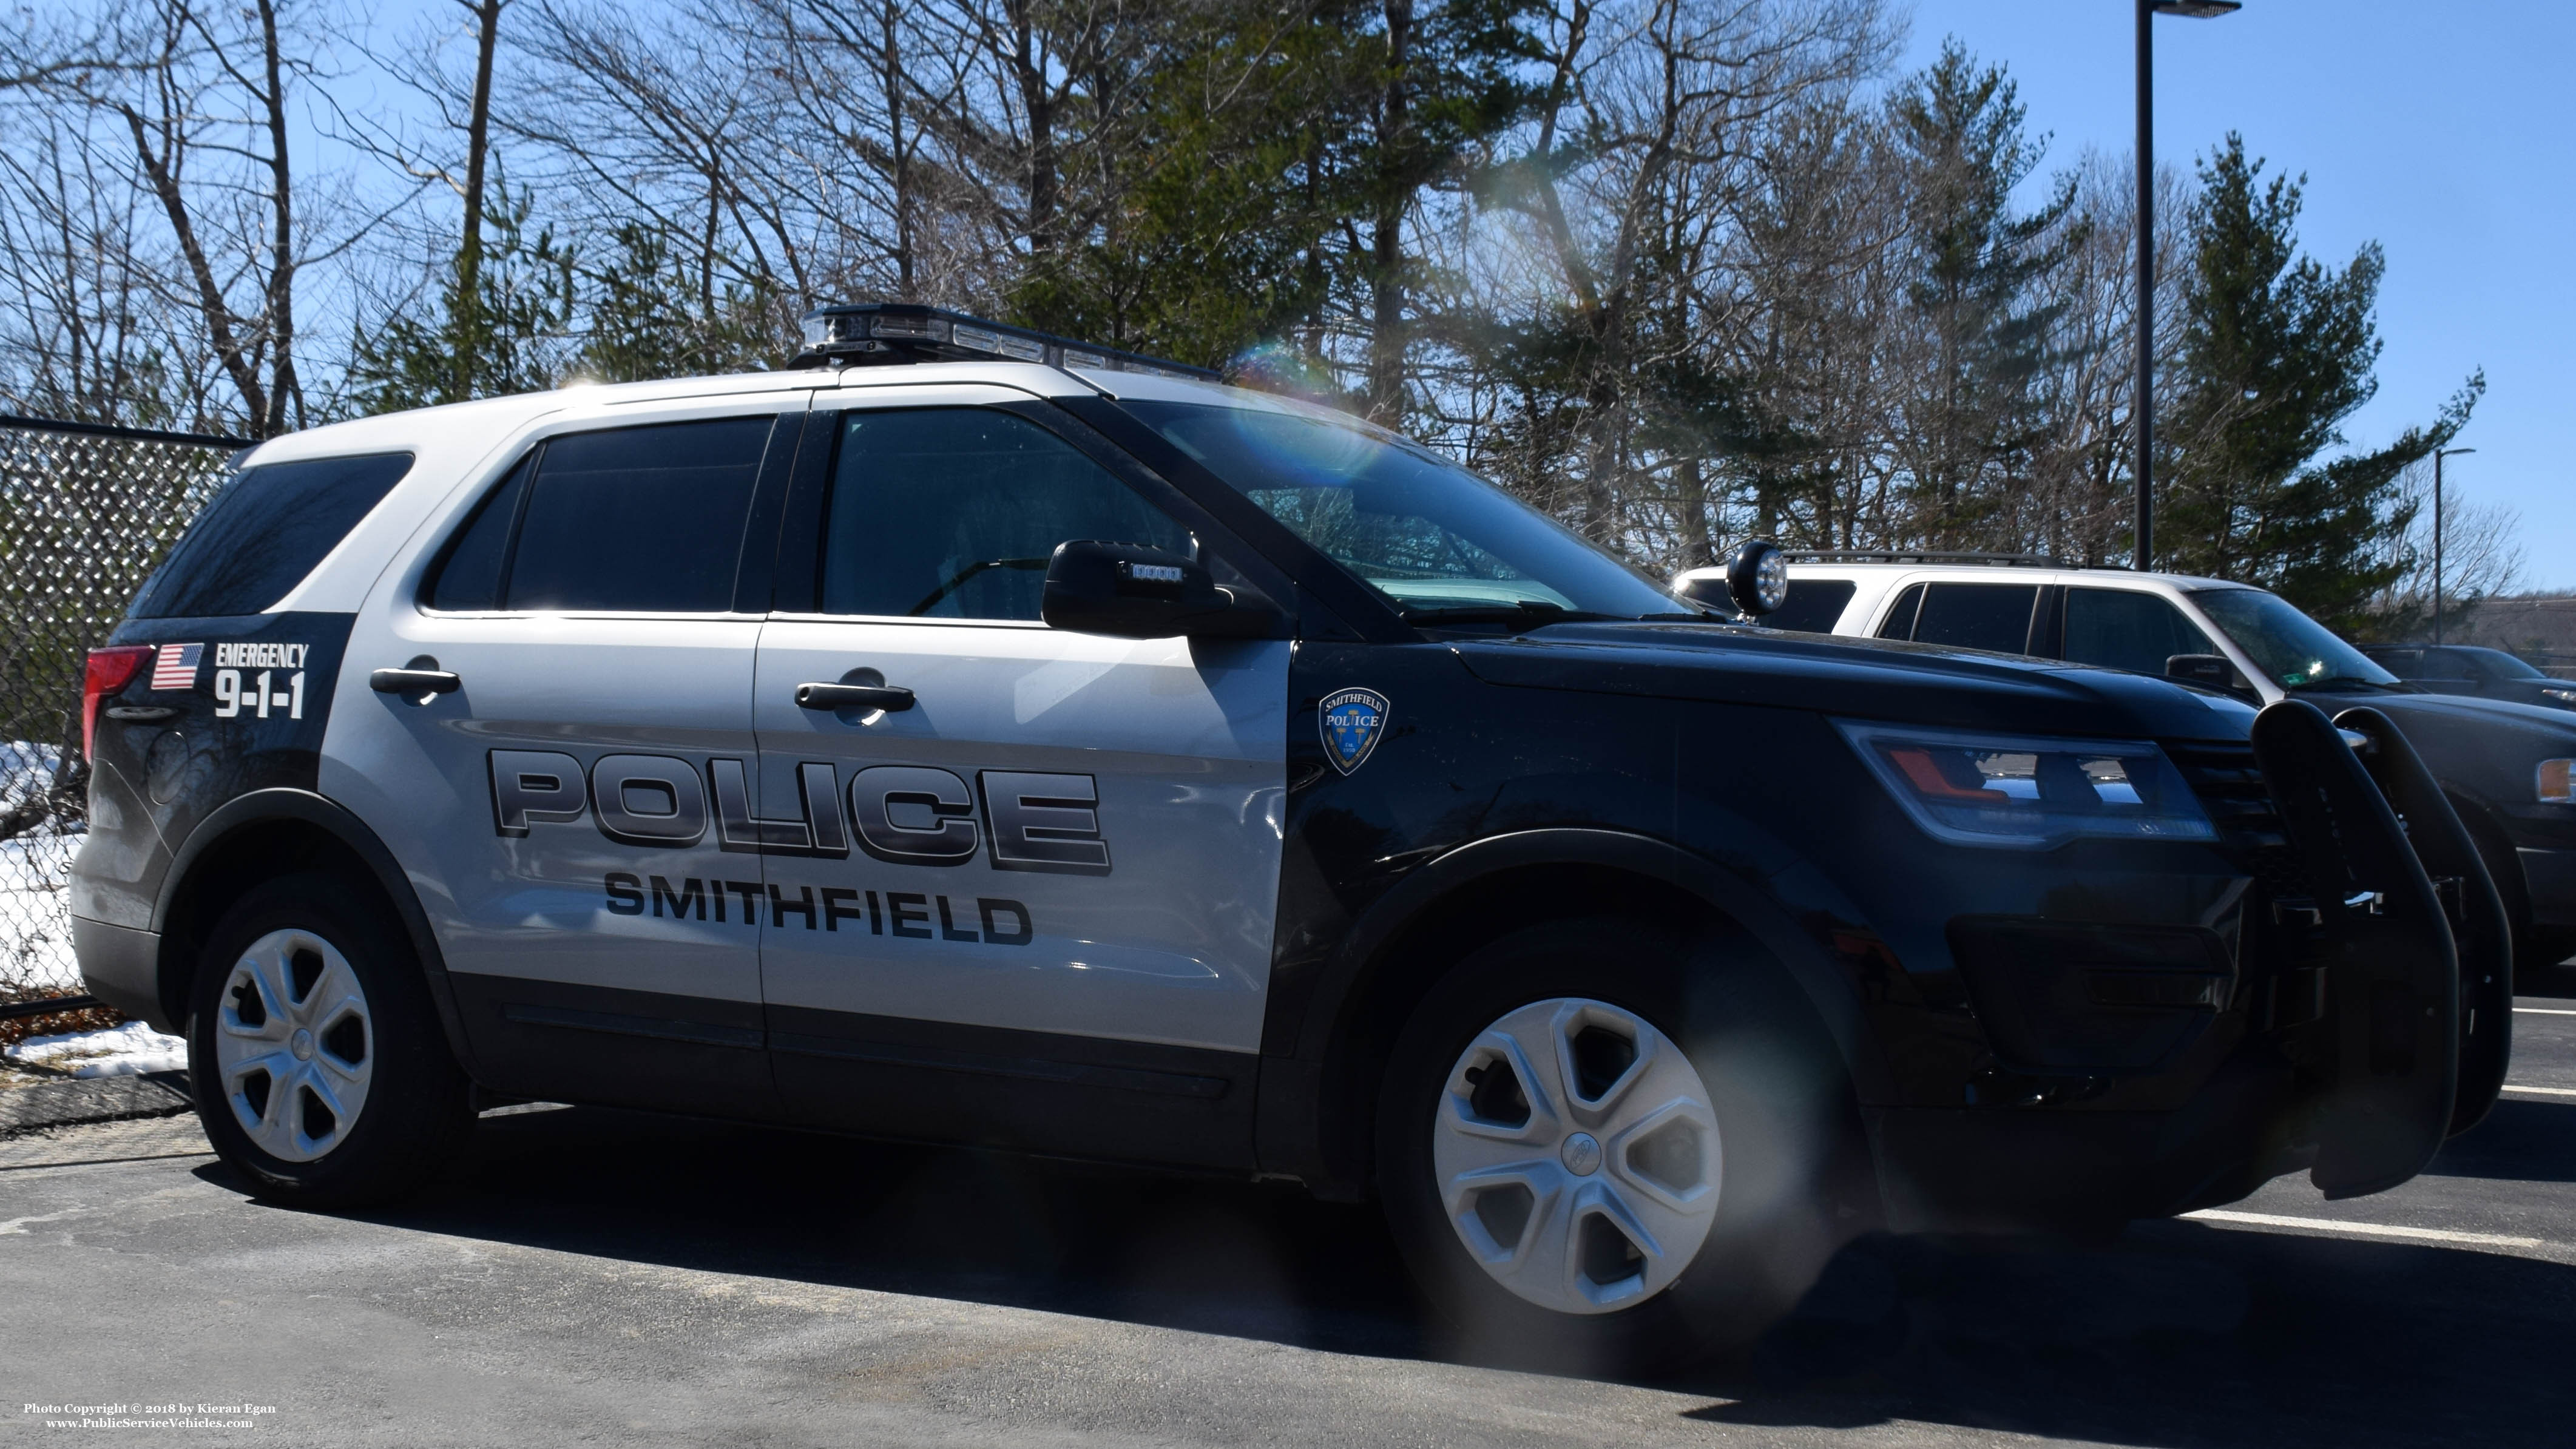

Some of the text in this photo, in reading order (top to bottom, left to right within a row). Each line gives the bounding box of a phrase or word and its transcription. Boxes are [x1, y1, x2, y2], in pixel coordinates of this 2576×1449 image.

[216, 643, 309, 667] EMERGENCY
[215, 670, 305, 719] 9-1-1
[1325, 694, 1382, 712] SMITHFIELD
[1325, 715, 1379, 726] POLICE
[487, 748, 1113, 876] POLICE
[606, 871, 1033, 946] SMITHFIELD
